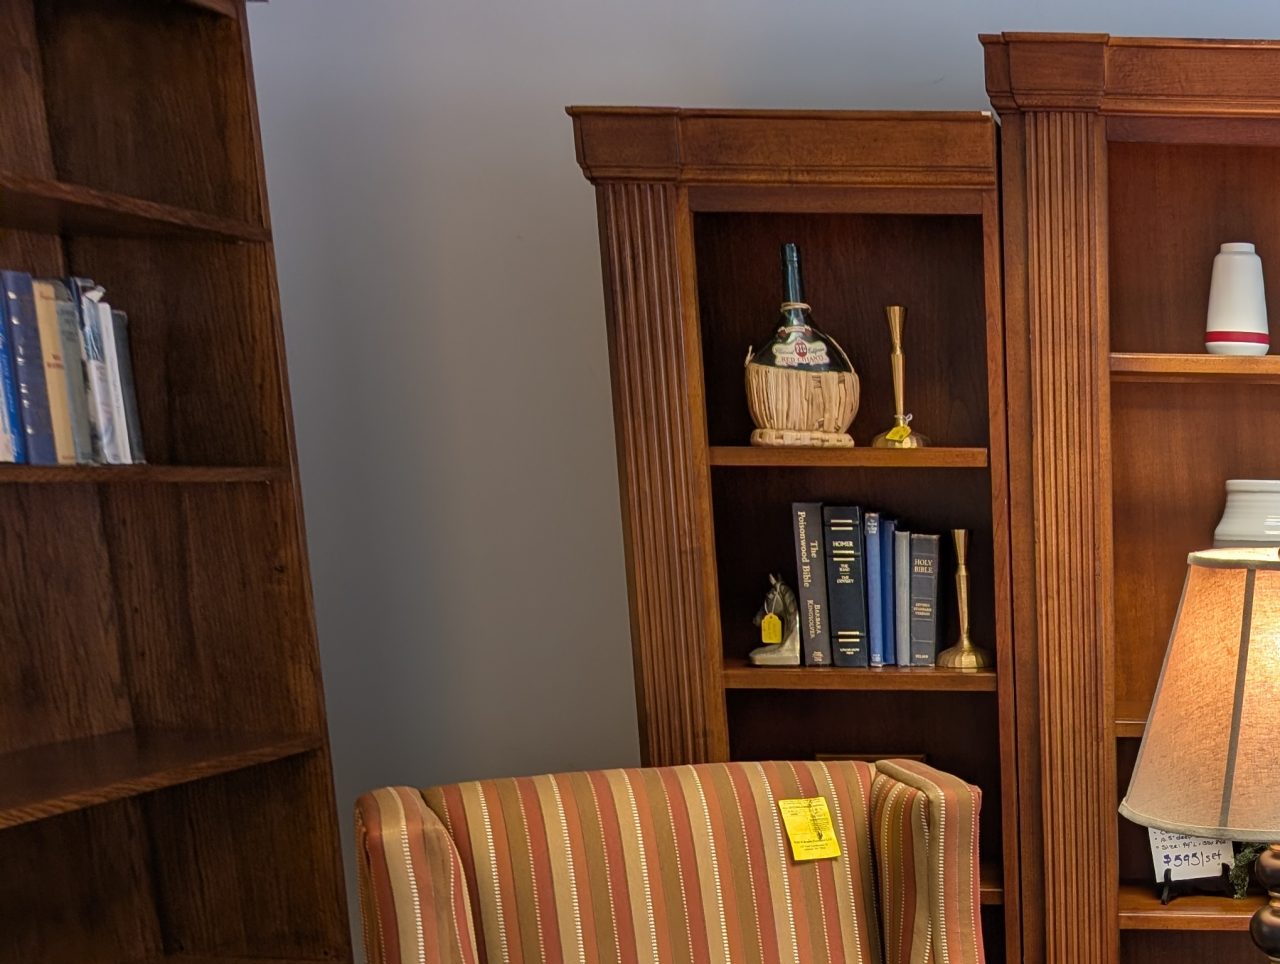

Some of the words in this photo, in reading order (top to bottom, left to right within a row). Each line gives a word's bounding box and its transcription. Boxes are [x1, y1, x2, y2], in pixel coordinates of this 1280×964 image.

[798, 511, 809, 563] Poisonwood
[810, 540, 819, 558] The
[802, 565, 811, 588] Bible
